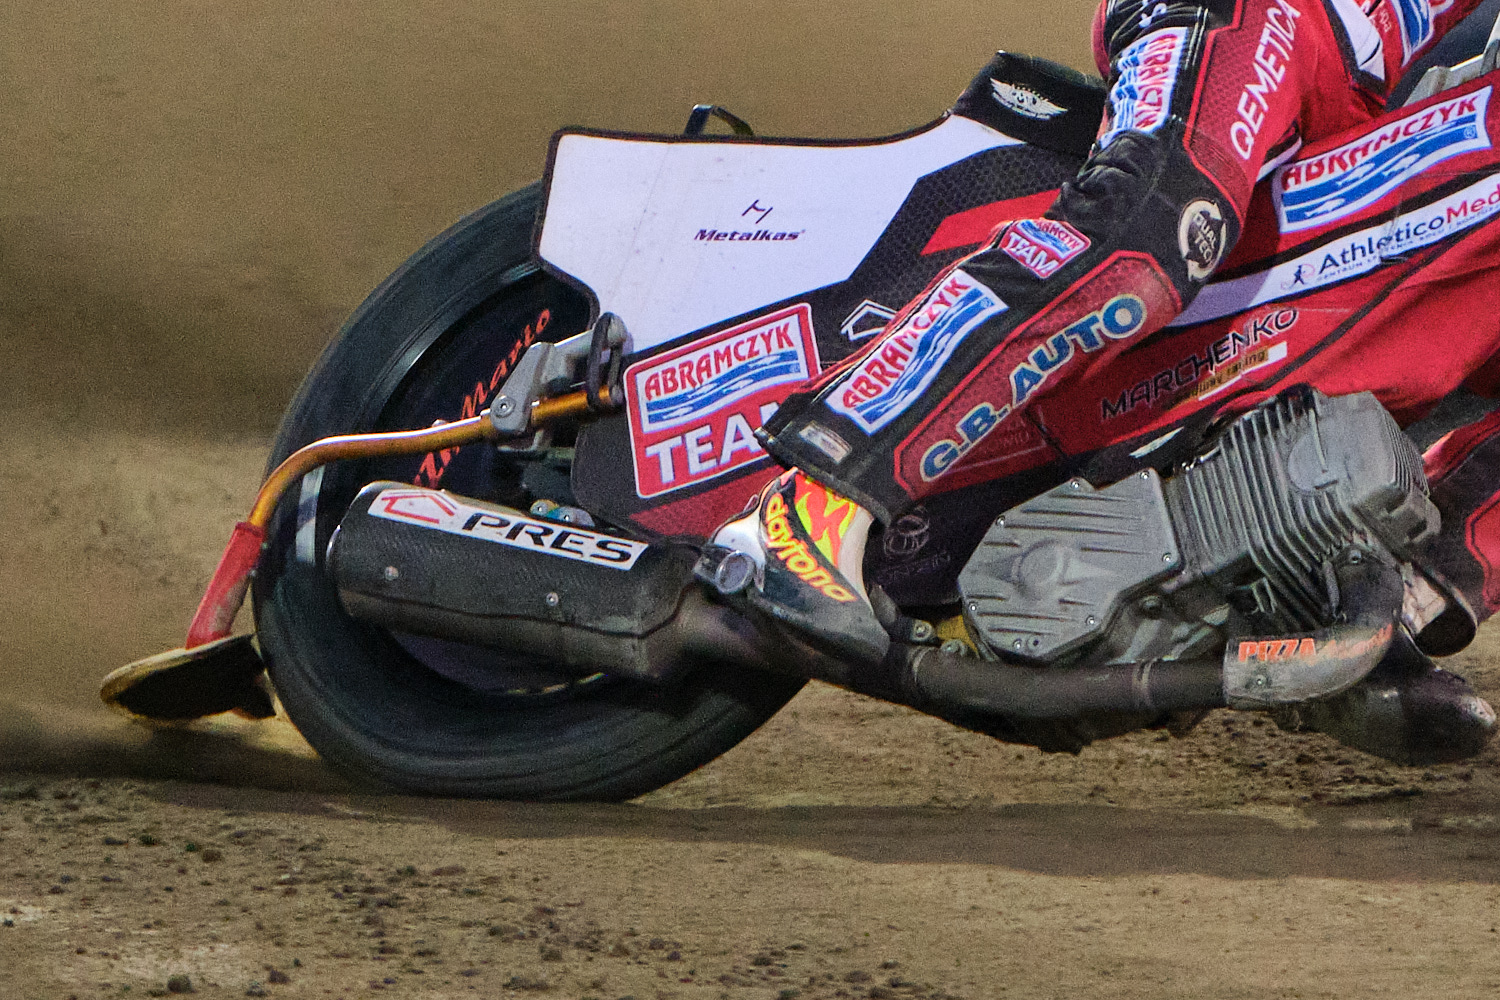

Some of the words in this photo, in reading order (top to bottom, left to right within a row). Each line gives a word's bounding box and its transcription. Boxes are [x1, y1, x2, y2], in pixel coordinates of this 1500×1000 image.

[1229, 3, 1301, 160] QEMETICA
[1280, 95, 1479, 191] ABRAMCZYK
[694, 228, 801, 243] Metalkas
[1006, 231, 1059, 274] TEAM
[644, 322, 796, 400] ABRAMCZYK
[842, 275, 970, 410] ABRAMCZYK
[1102, 308, 1300, 420] MARCHENKO
[461, 512, 637, 564] PRES
[766, 492, 858, 603] daytona
[1238, 638, 1316, 662] PIZZA
